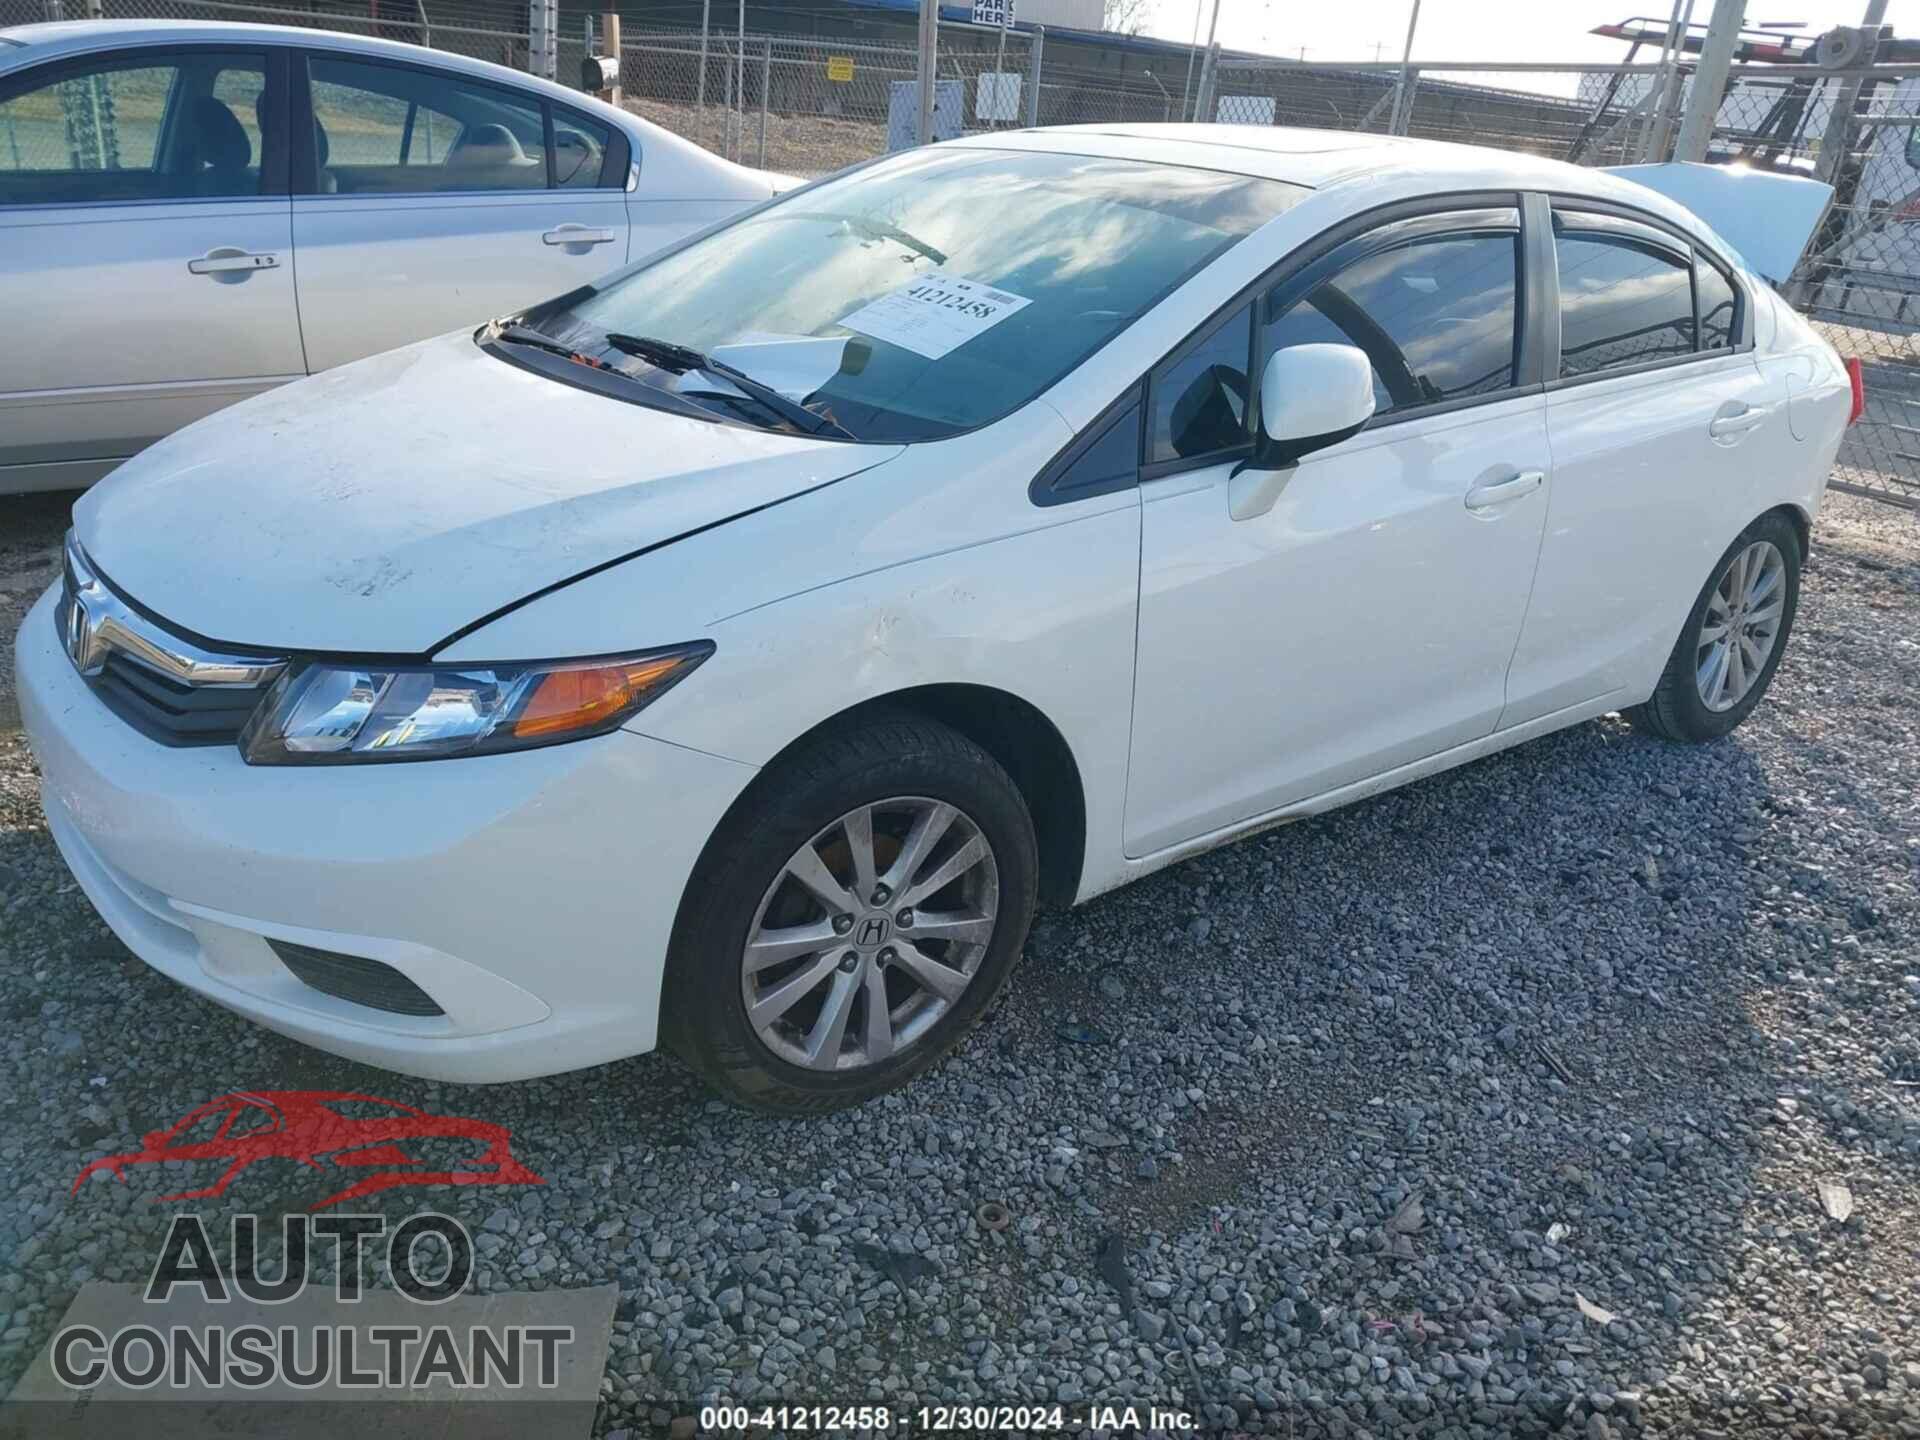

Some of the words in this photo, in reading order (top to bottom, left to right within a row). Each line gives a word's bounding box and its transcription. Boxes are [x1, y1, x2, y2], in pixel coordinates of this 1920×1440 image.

[975, 0, 1015, 12] PARK
[973, 9, 1014, 26] HERE
[908, 285, 997, 319] 41212458
